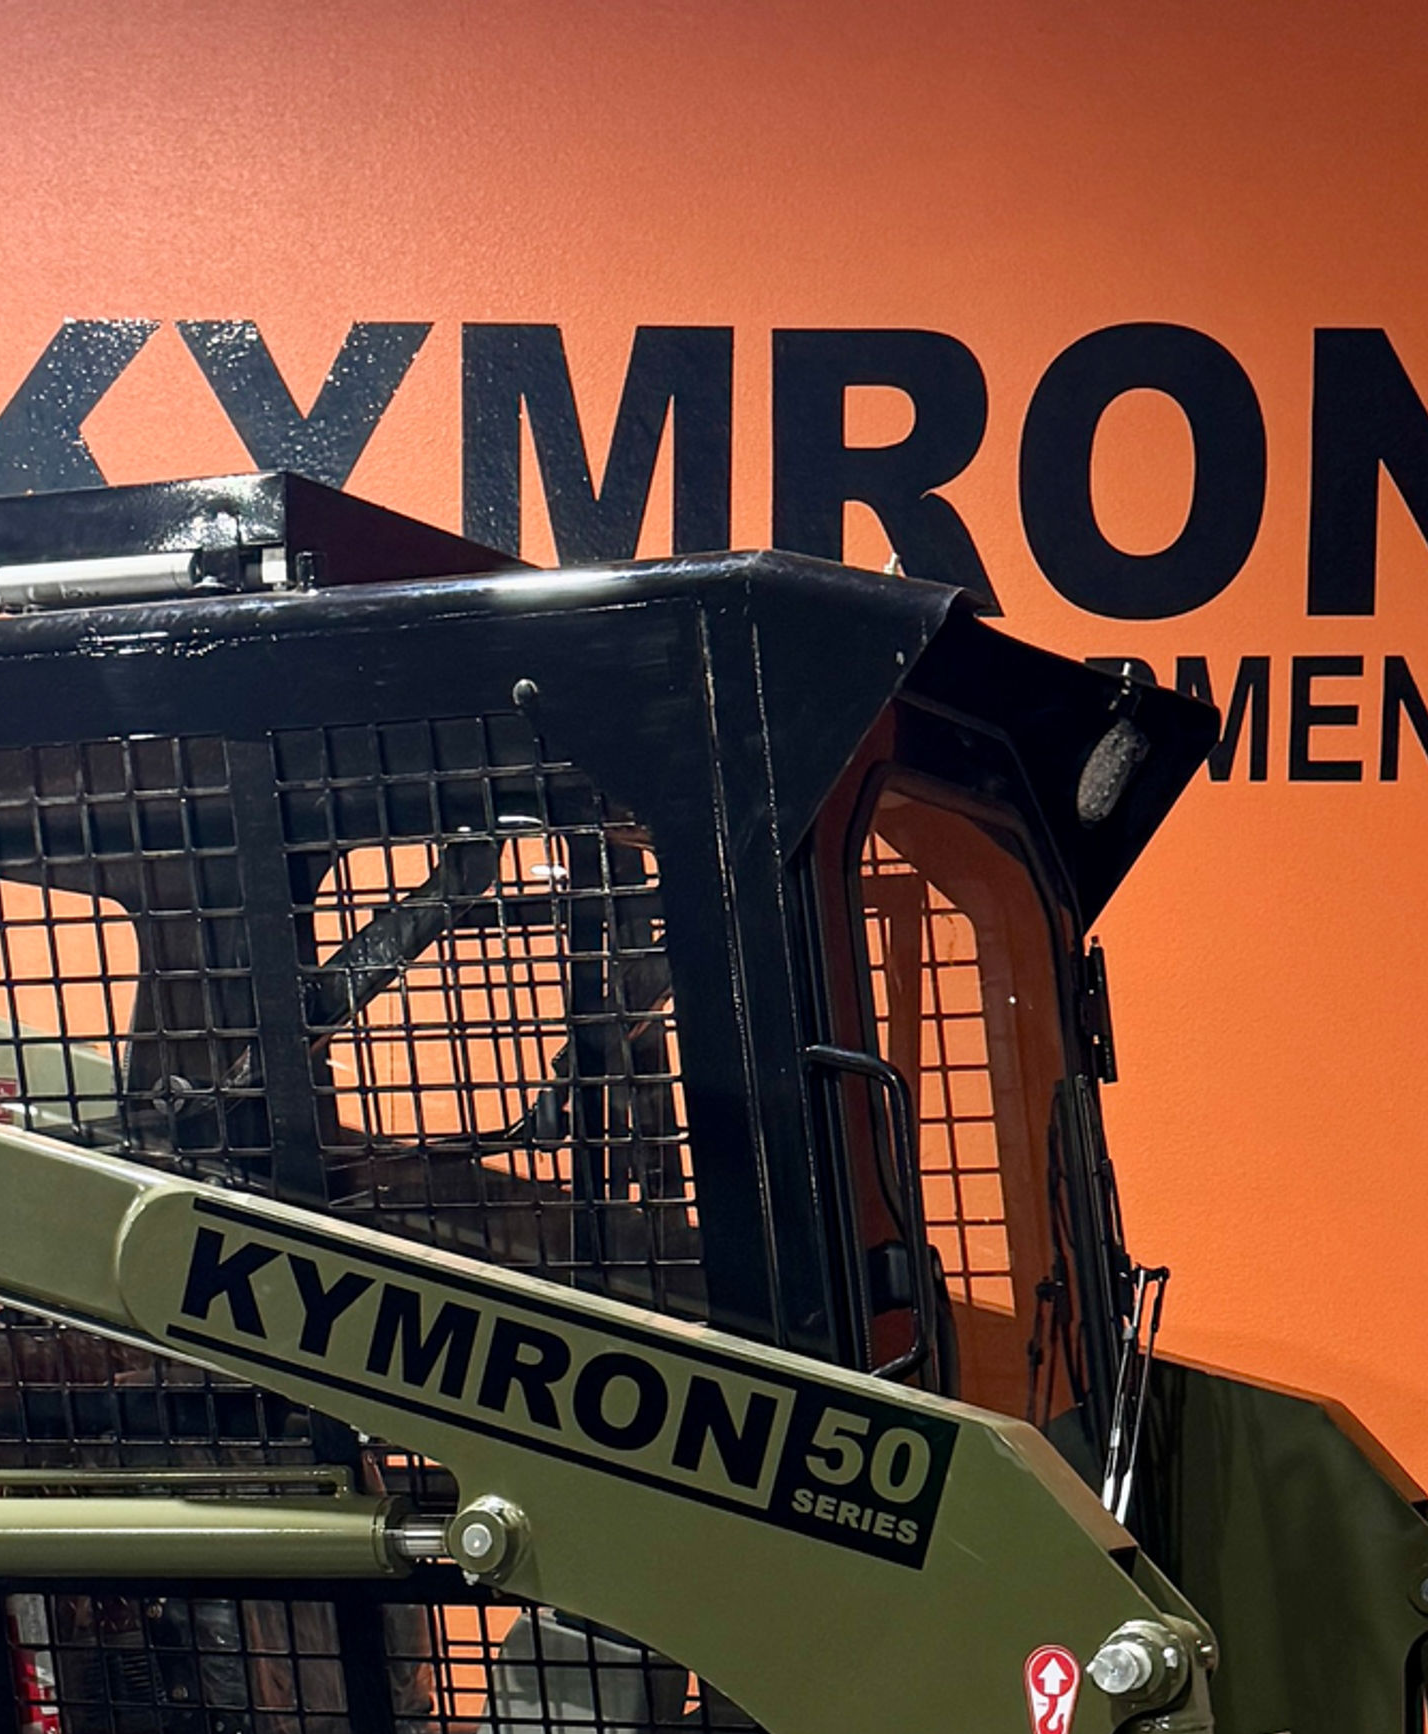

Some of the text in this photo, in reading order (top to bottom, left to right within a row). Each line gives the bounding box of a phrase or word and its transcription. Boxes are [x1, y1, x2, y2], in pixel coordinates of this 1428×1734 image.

[180, 1226, 783, 1491] KYMRON
[805, 1406, 931, 1504] 50
[791, 1488, 919, 1545] SERIES
